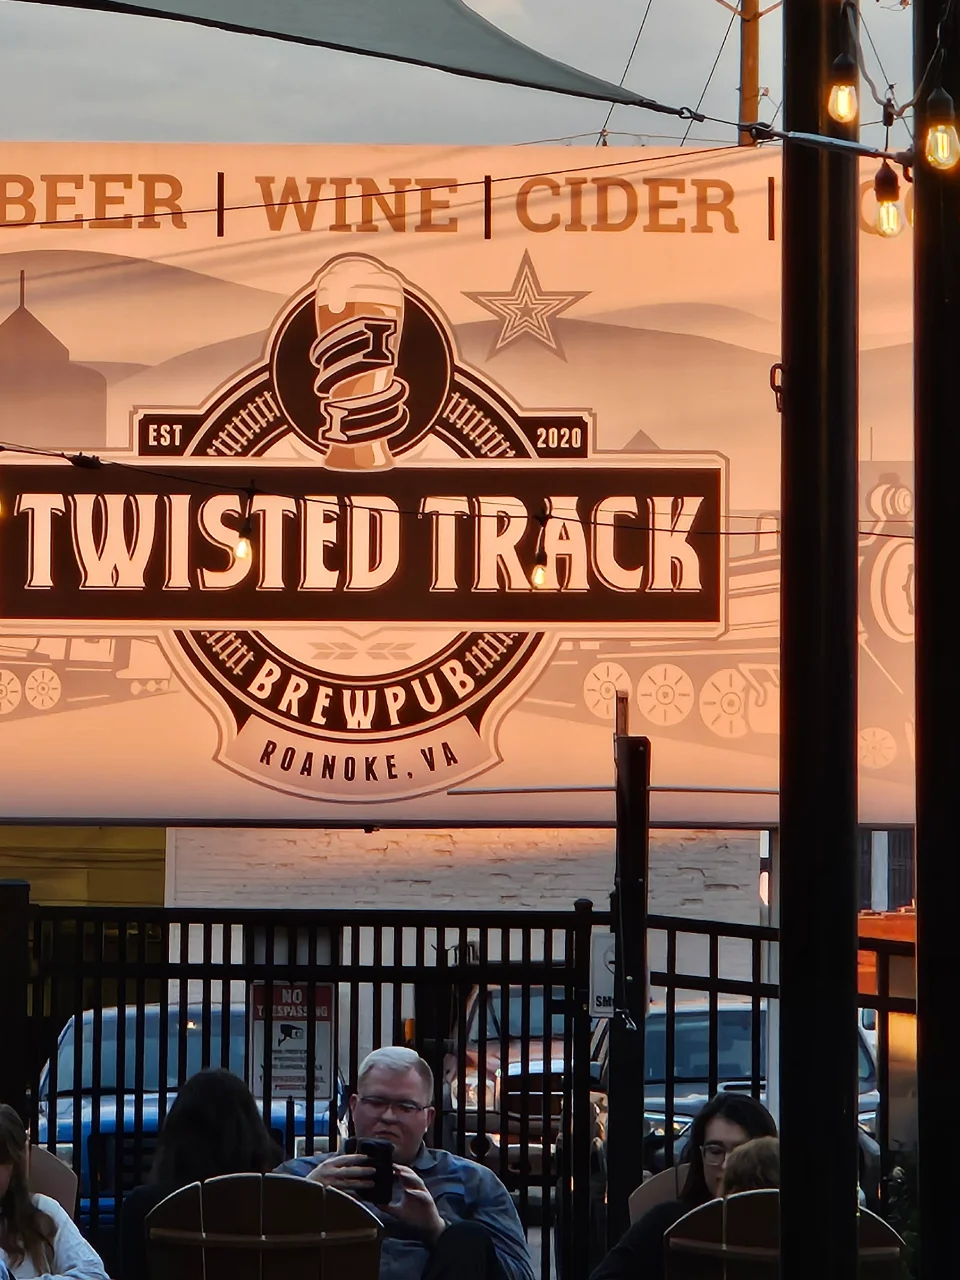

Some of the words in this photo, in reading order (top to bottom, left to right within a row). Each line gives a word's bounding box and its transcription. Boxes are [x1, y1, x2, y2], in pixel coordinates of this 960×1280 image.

[255, 176, 459, 233] WINE
[516, 176, 739, 234] CIDER
[148, 424, 183, 446] EST
[537, 427, 581, 448] 2020
[14, 493, 400, 592] TWISTED
[417, 496, 704, 593] TRACK
[247, 659, 475, 729] BREWPUB
[259, 739, 413, 782] ROANOKE,
[421, 742, 459, 772] VA
[256, 1004, 328, 1017] TESPASSNG
[282, 988, 303, 1004] NO
